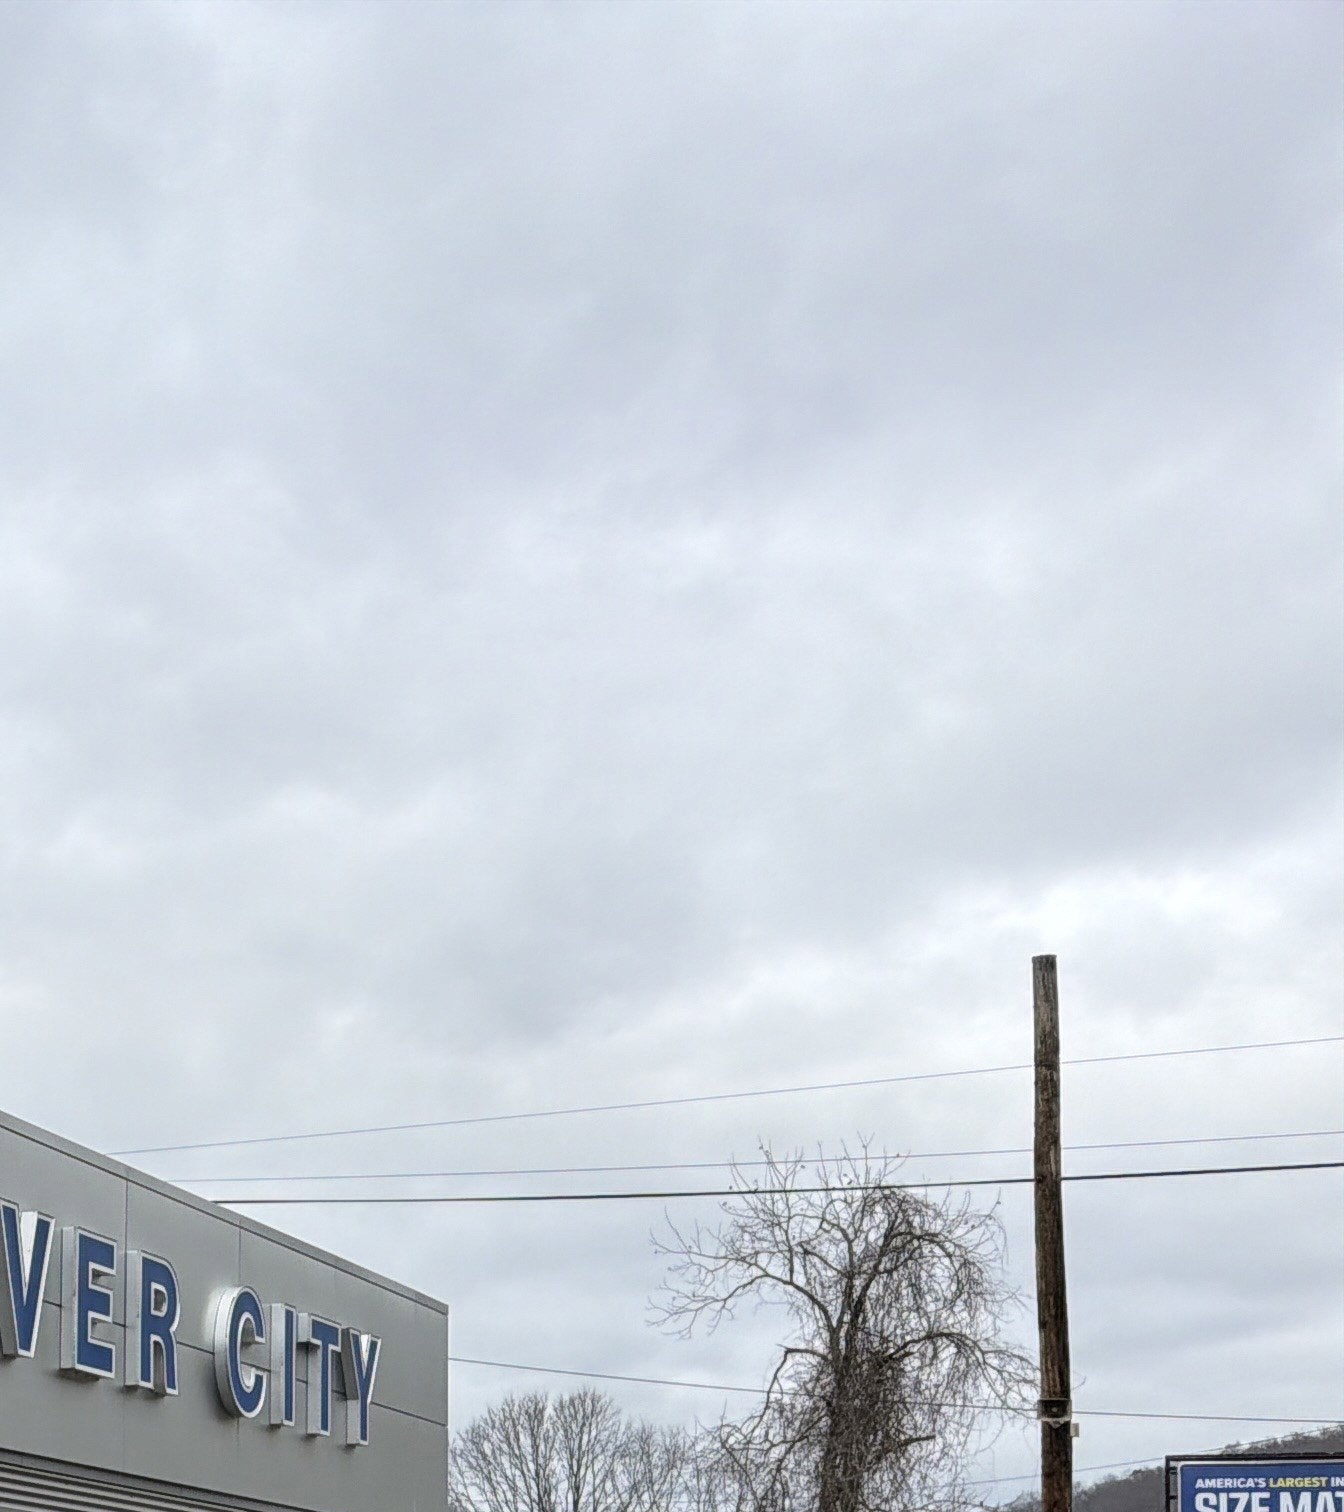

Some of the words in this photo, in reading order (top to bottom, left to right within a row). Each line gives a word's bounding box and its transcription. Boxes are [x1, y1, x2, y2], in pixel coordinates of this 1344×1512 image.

[214, 1285, 382, 1446] CITY
[1194, 1477, 1267, 1489] AMERICA'S
[1269, 1476, 1329, 1488] LARGEST
